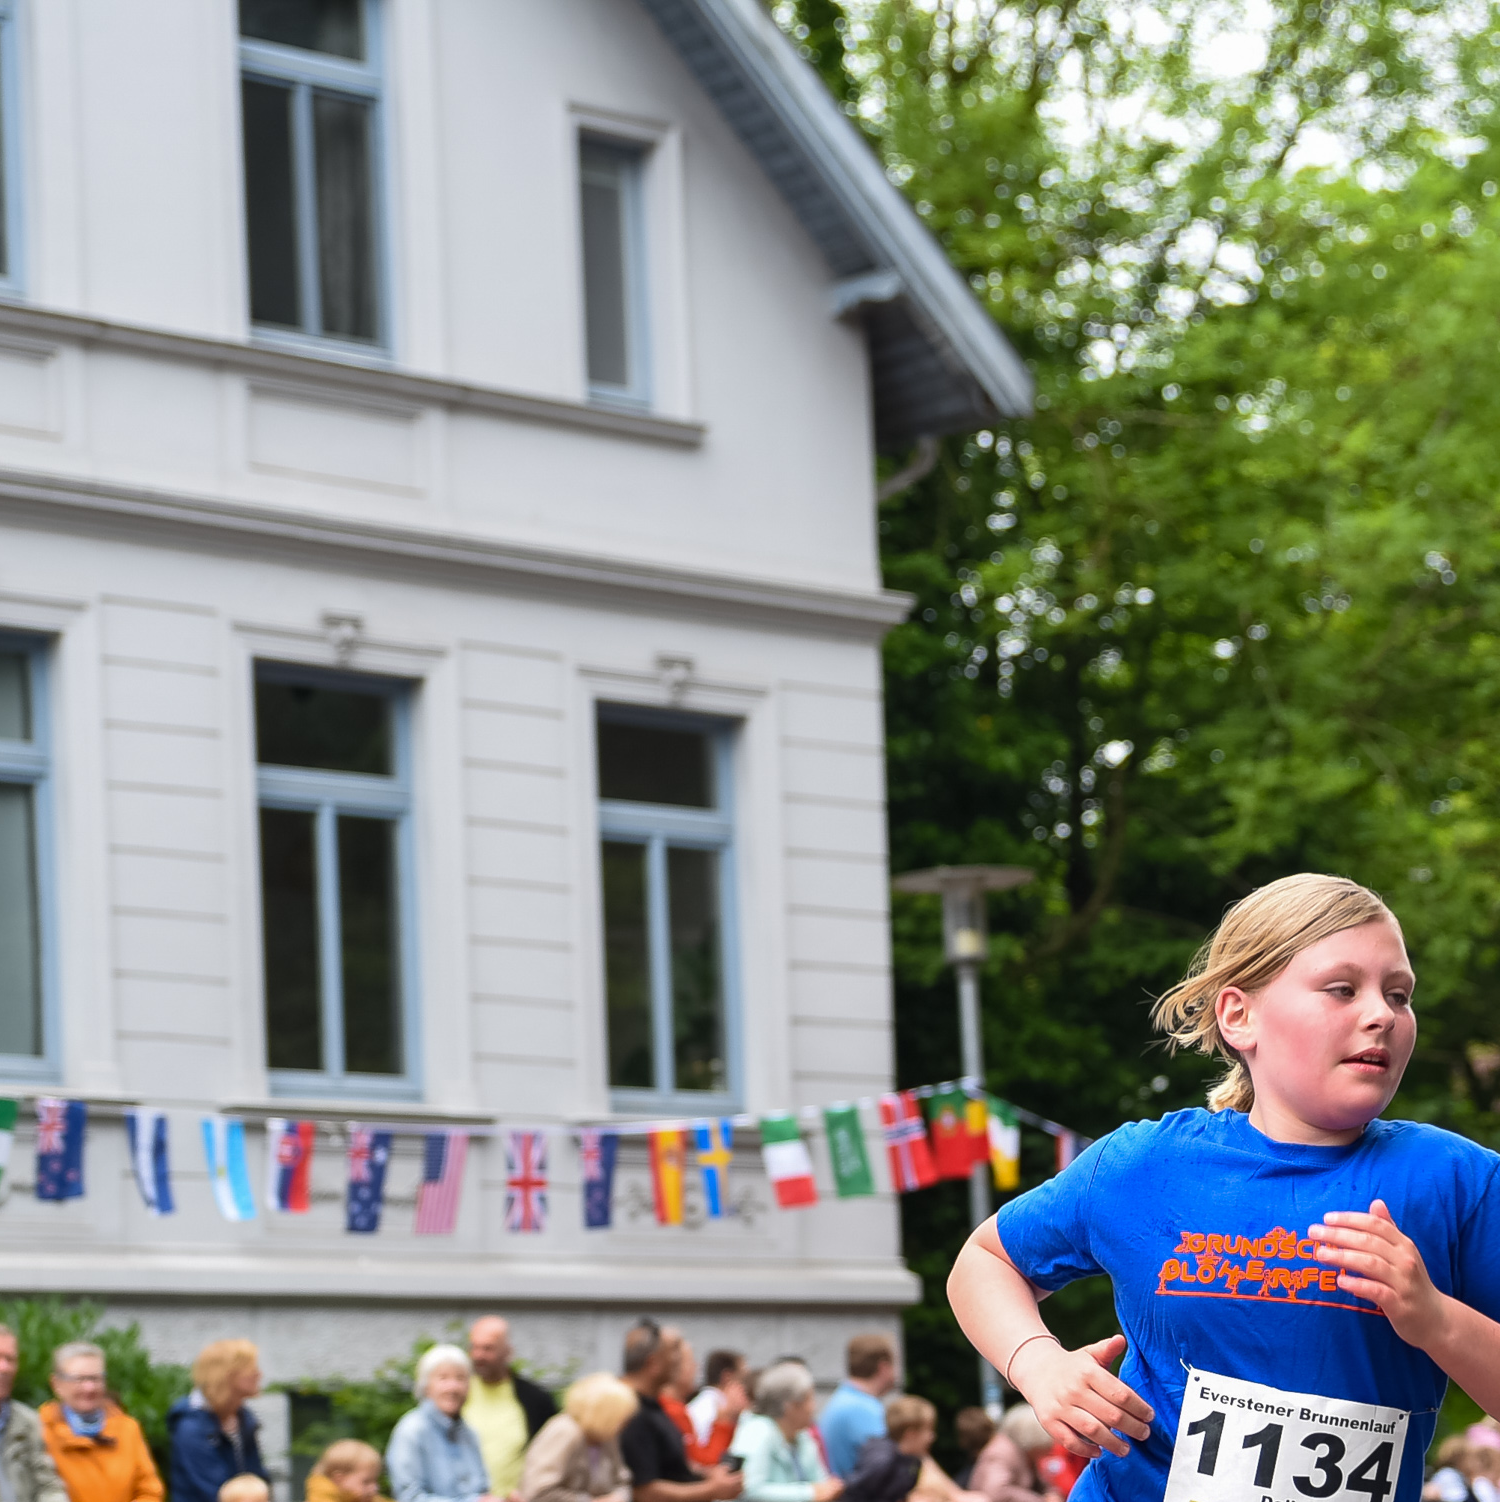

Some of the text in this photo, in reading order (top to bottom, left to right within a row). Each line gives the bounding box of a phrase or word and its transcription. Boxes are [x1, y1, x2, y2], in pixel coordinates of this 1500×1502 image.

[1186, 1229, 1338, 1262] GRUNDSC
[1199, 1386, 1397, 1435] Everstener Brunnenlauf
